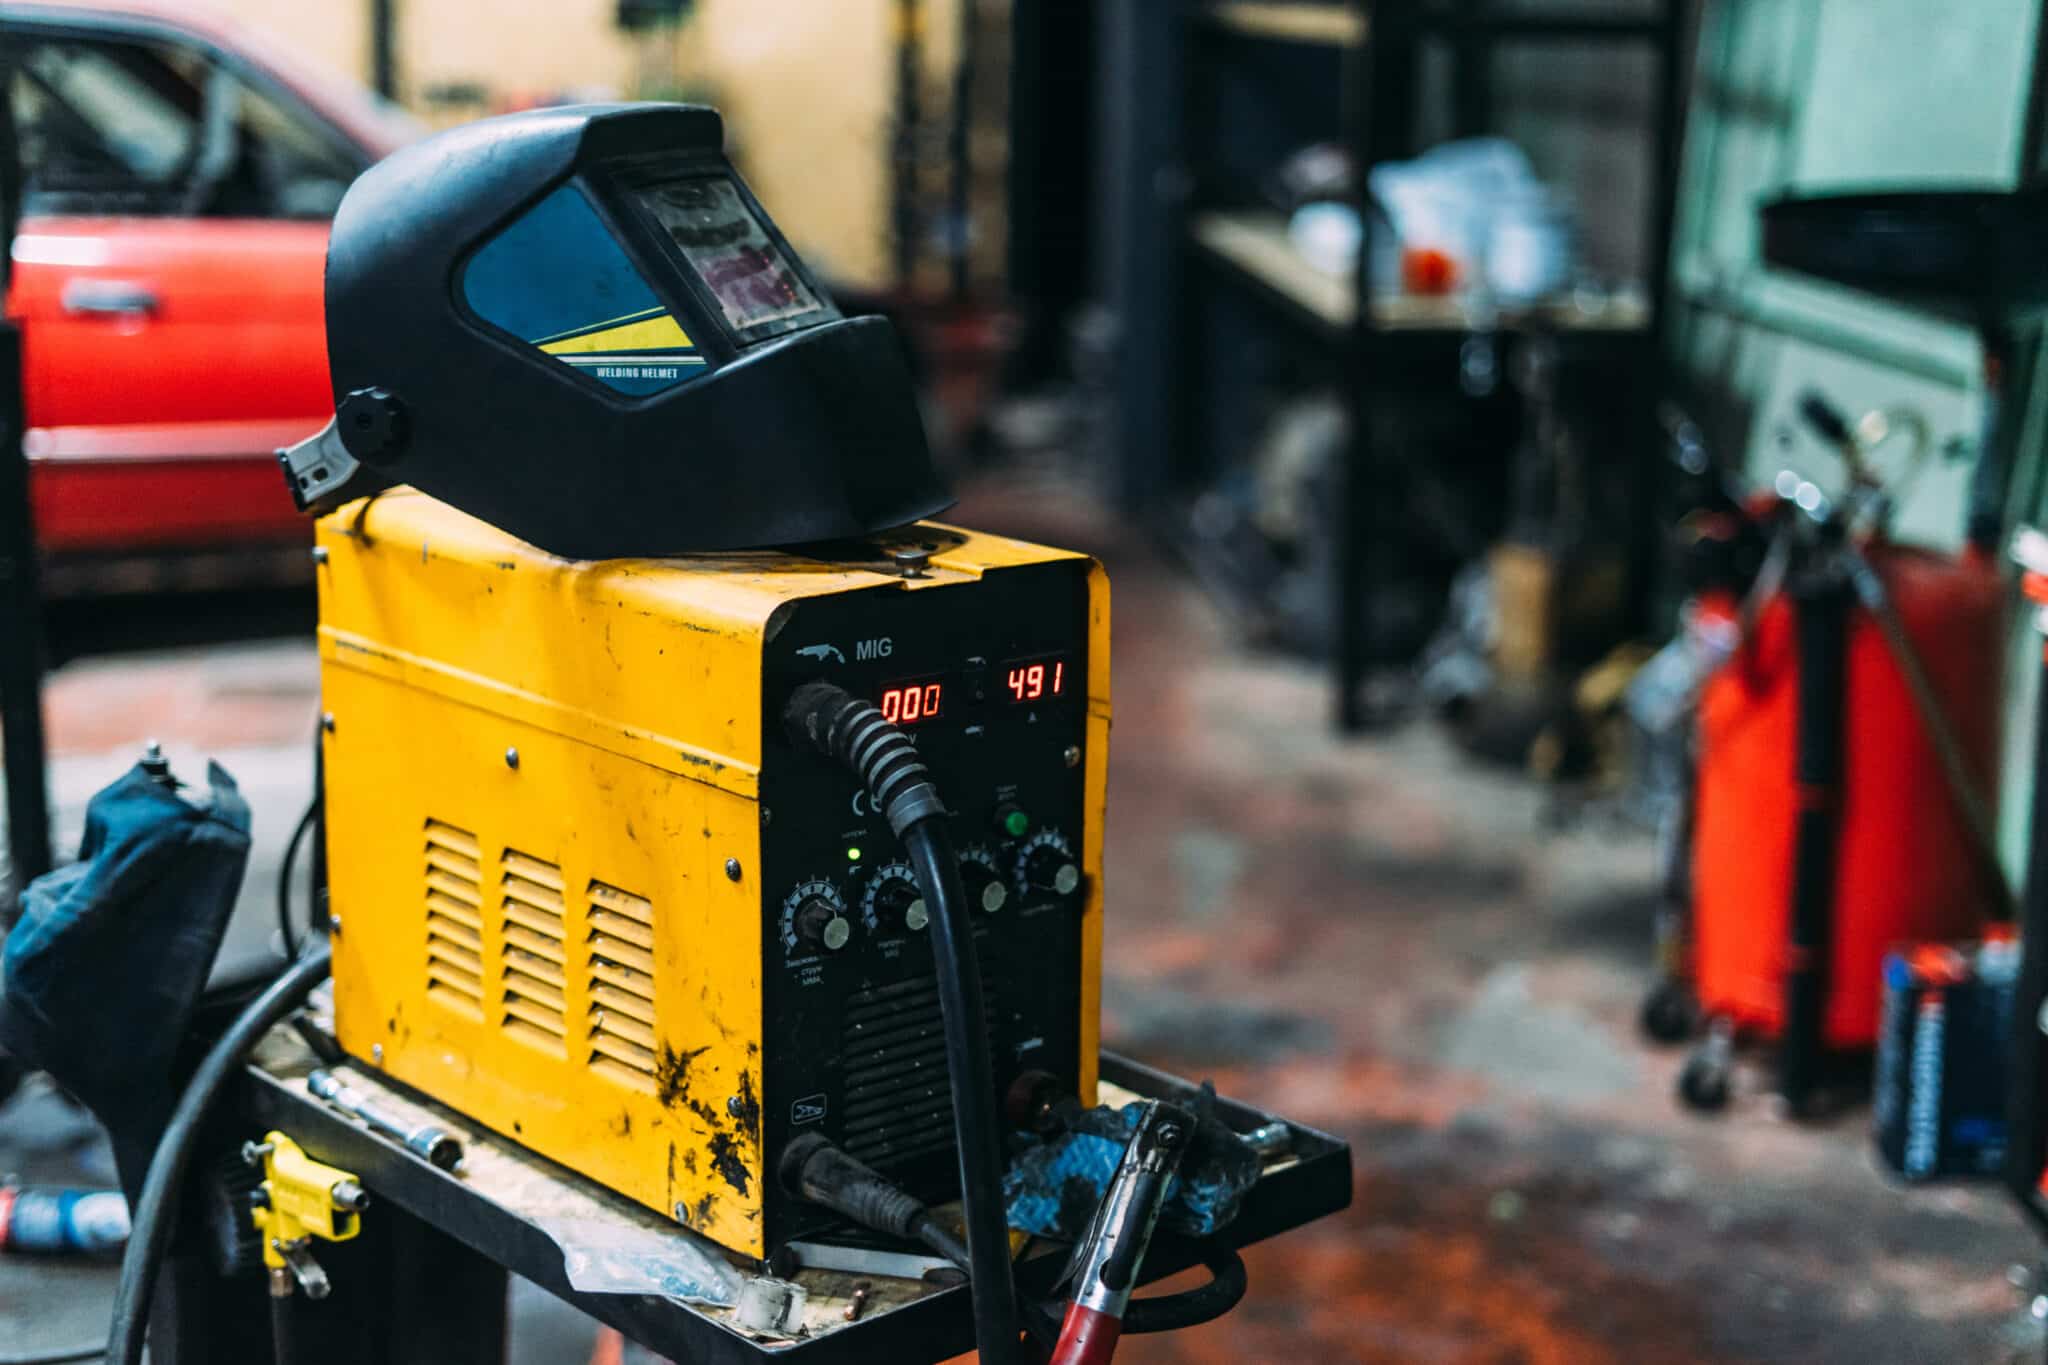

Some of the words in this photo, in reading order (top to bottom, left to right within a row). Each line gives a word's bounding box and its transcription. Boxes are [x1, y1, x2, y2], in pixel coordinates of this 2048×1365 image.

[597, 367, 639, 378] WELDING
[642, 367, 678, 379] HELMET
[856, 637, 892, 660] MIG
[1008, 661, 1063, 700] 491
